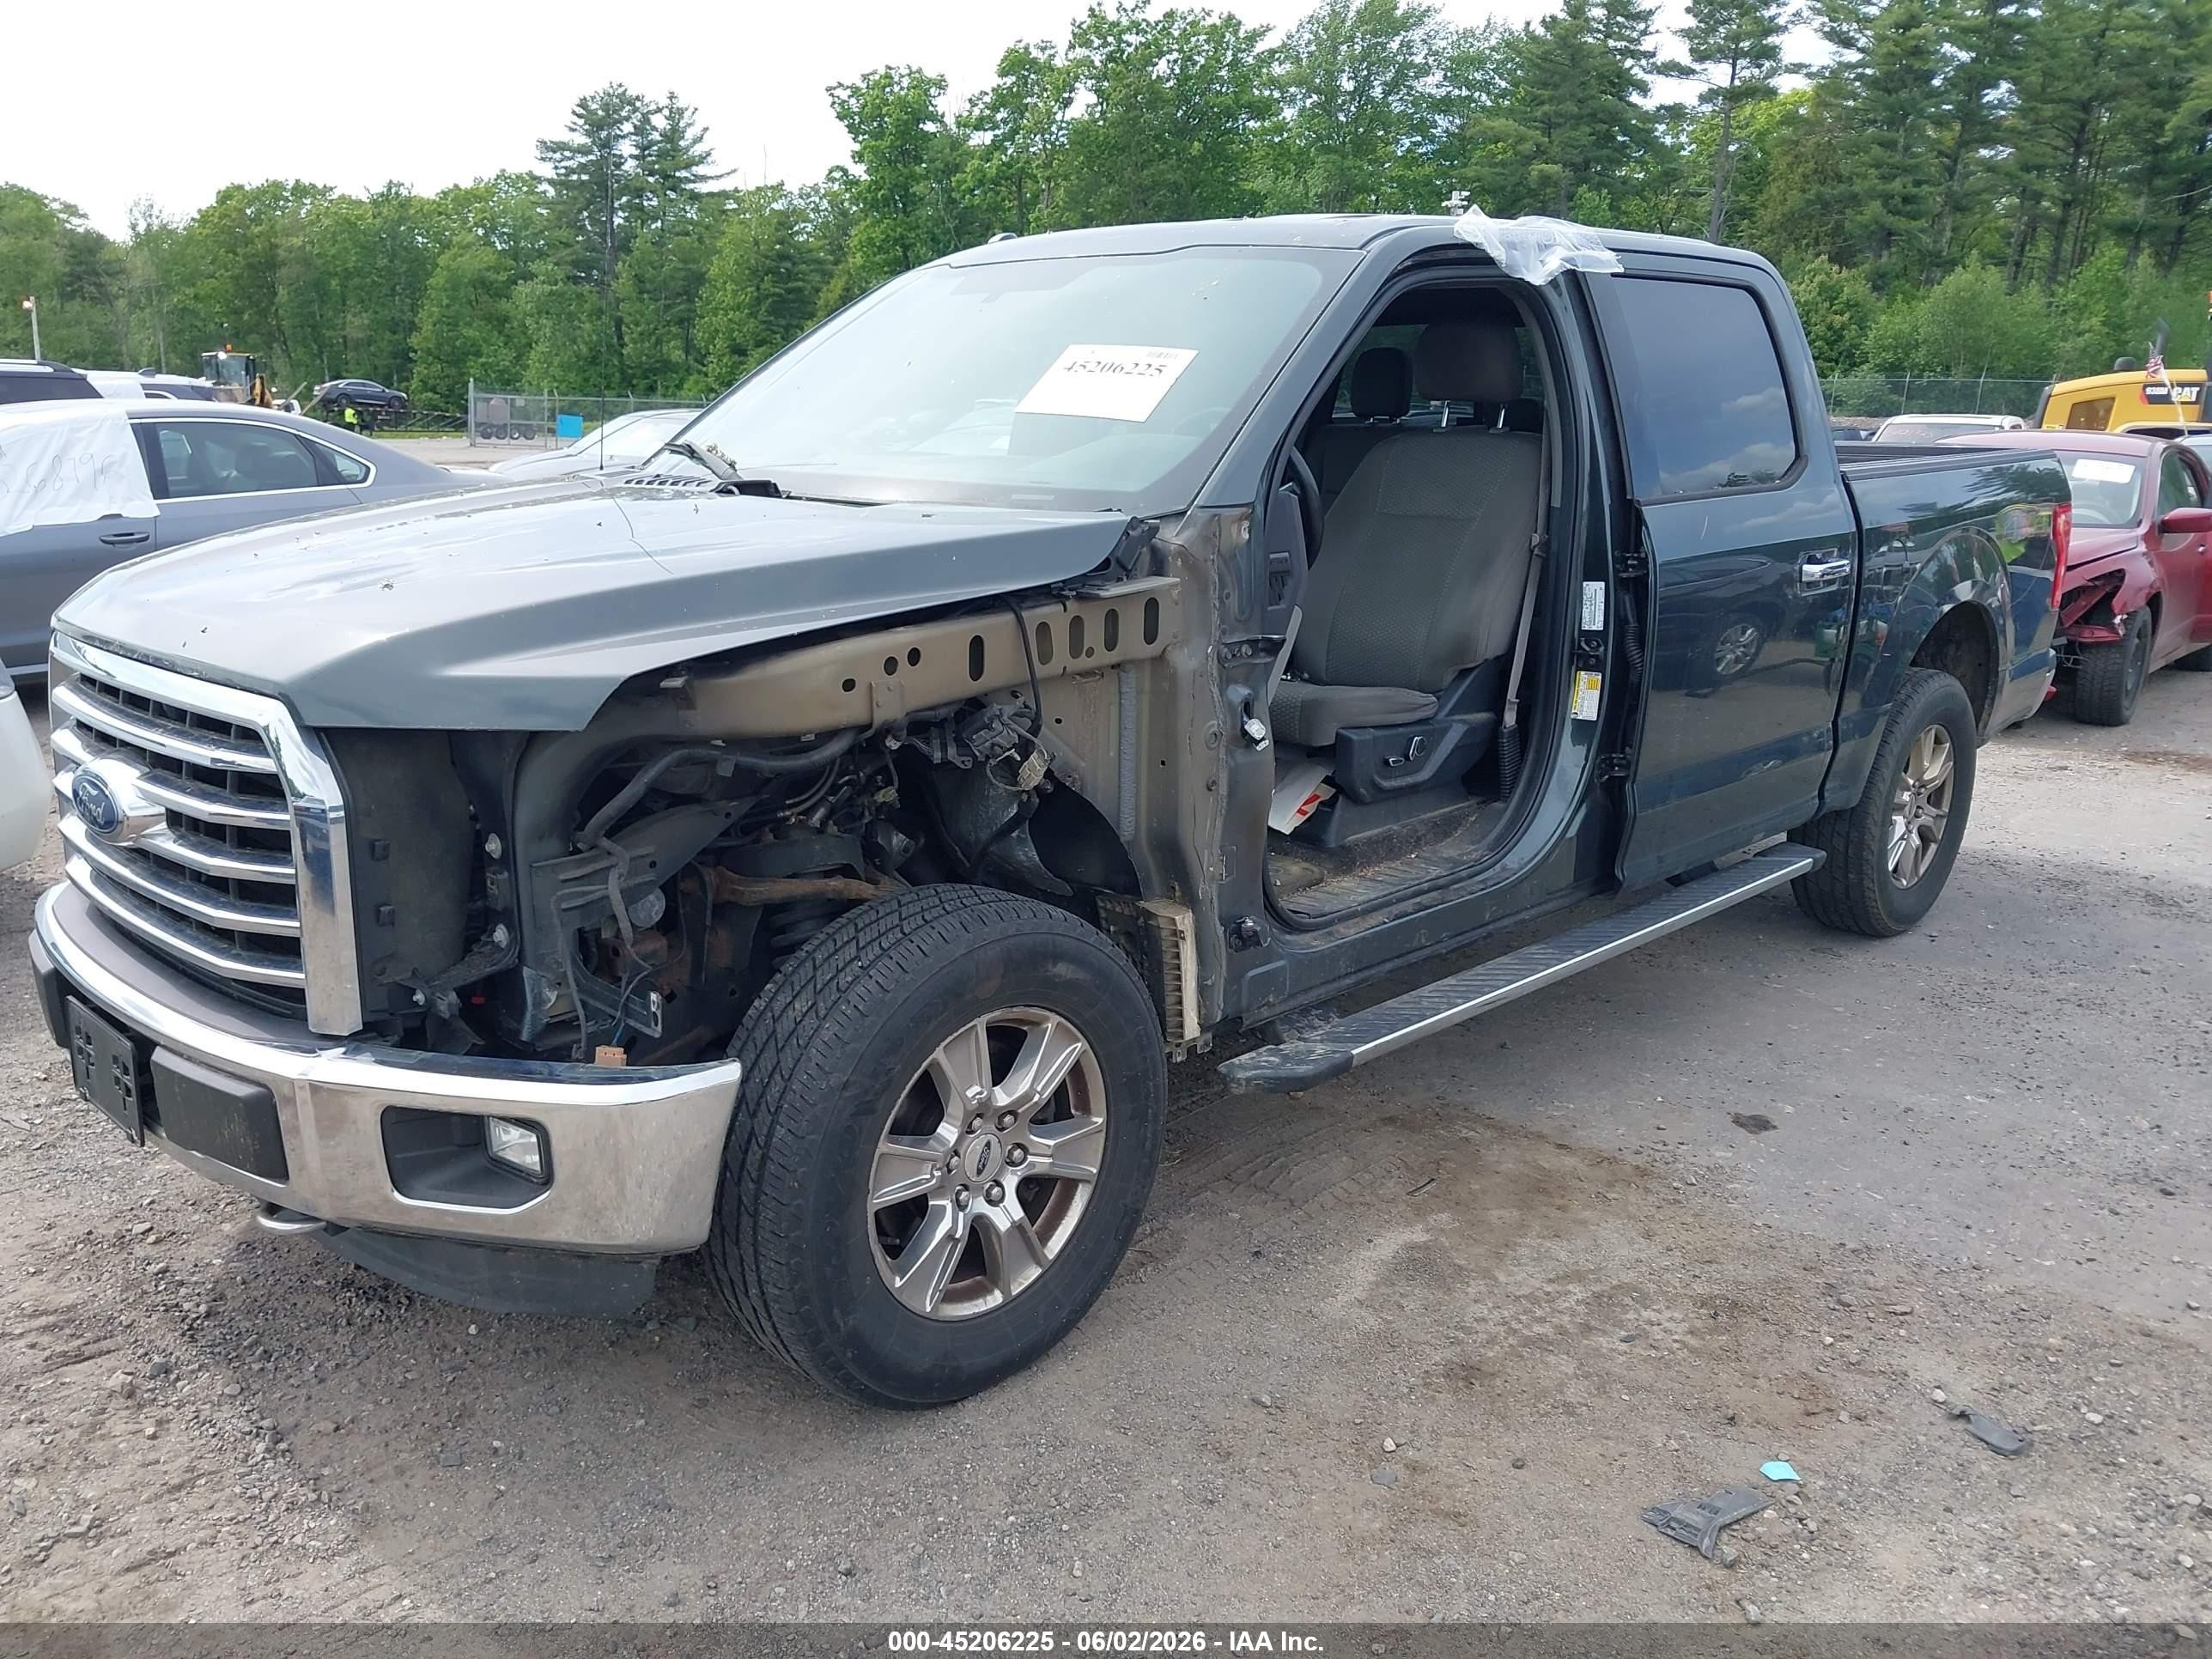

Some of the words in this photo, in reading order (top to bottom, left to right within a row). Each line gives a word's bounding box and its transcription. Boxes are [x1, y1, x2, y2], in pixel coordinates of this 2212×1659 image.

[1063, 361, 1169, 376] 45206225
[2172, 386, 2200, 402] CAT
[76, 782, 106, 826] Ford
